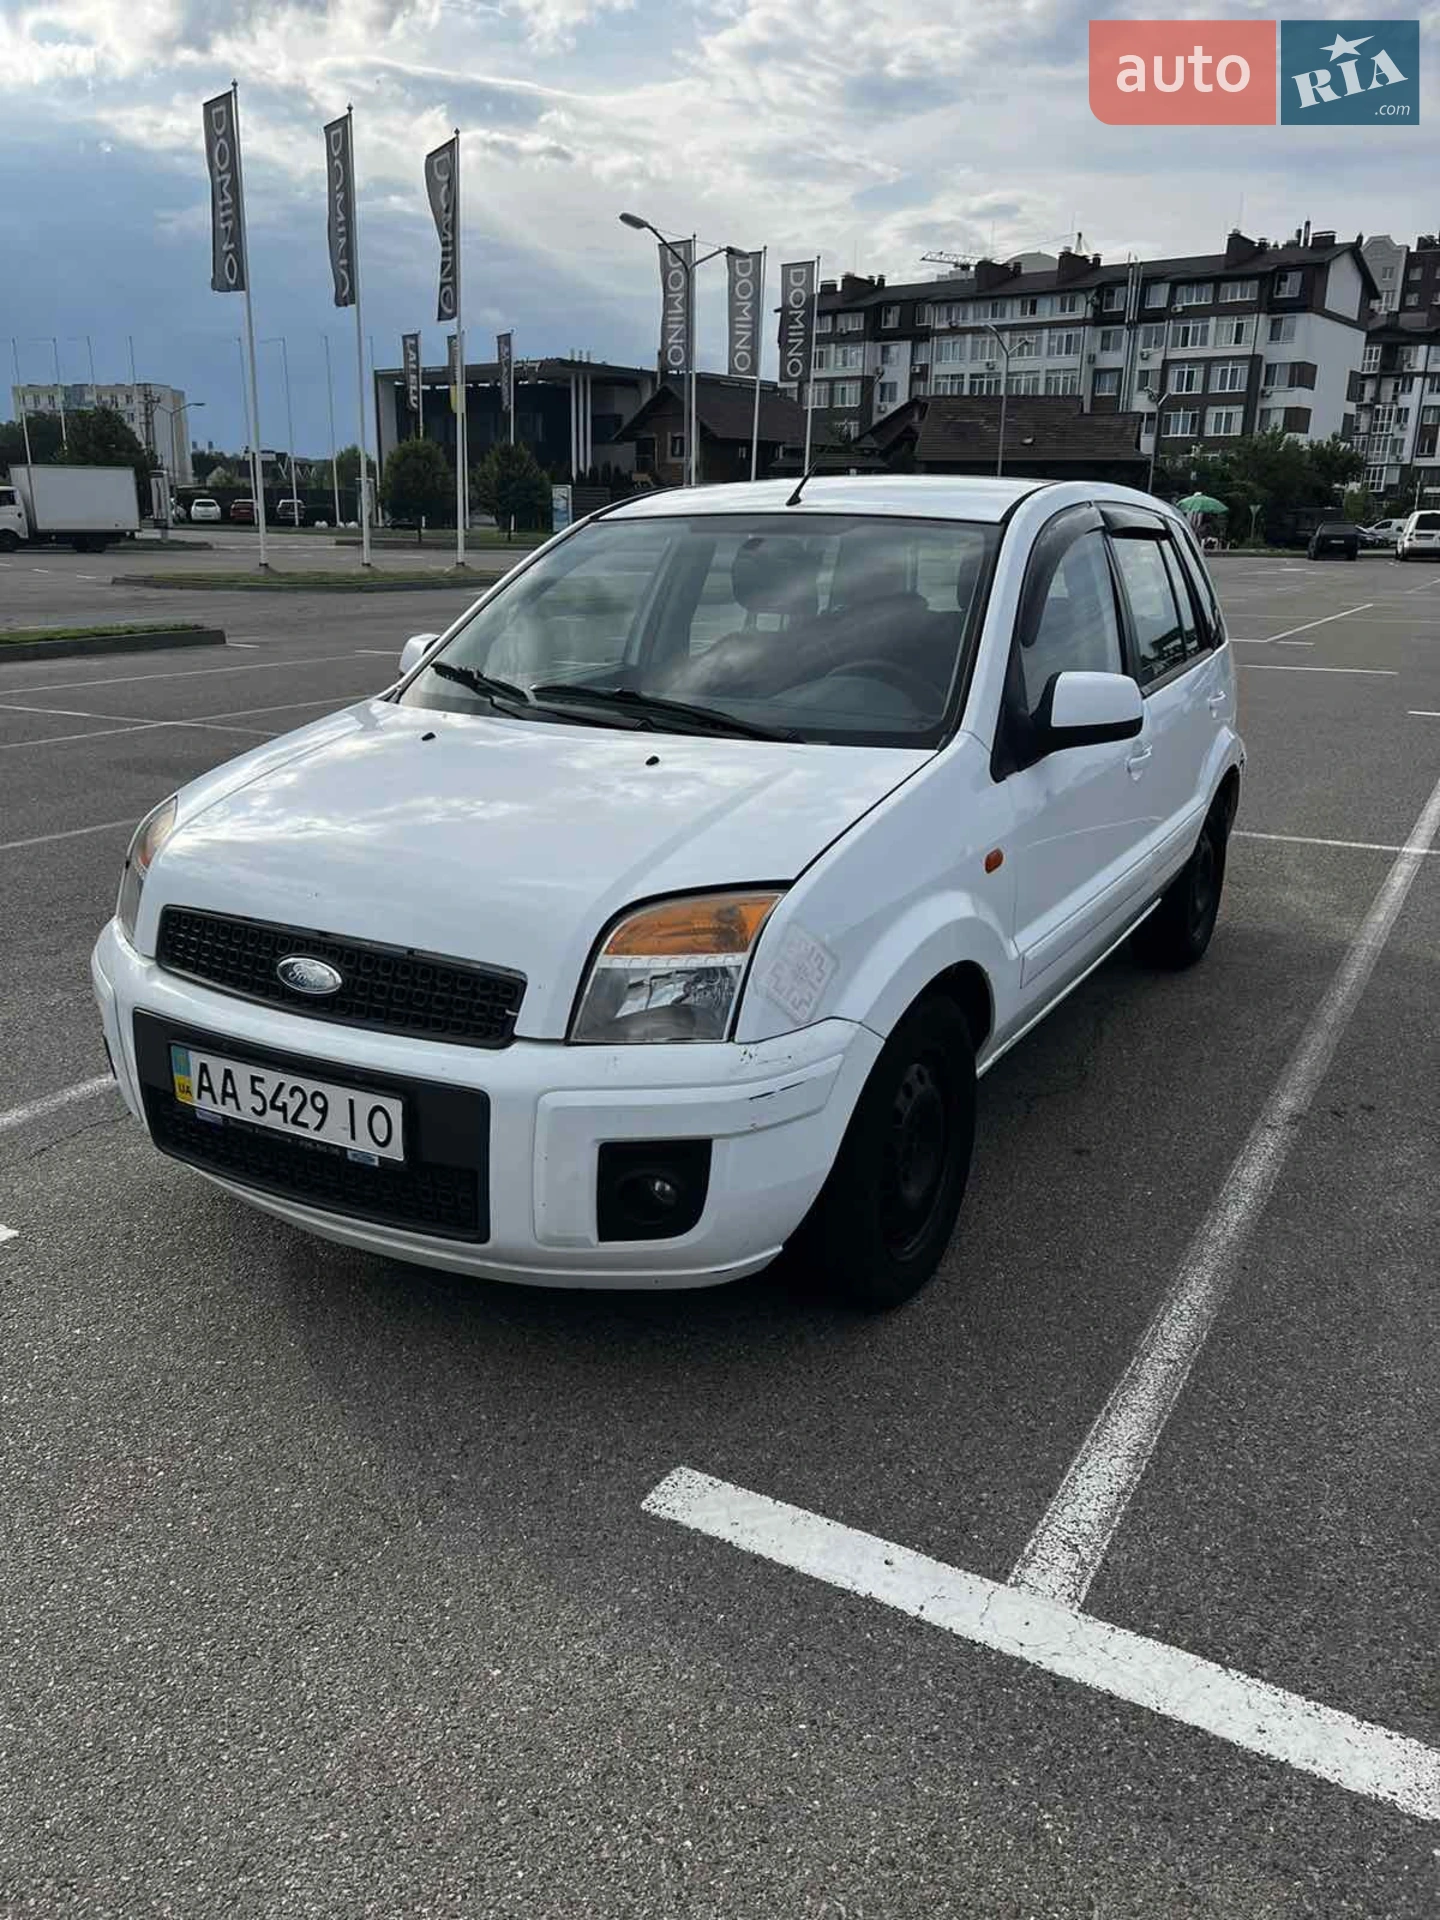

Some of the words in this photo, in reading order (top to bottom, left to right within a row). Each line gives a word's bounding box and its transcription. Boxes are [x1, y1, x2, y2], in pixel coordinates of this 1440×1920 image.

[212, 105, 238, 285] DOMINO
[667, 246, 686, 366] DOMINO
[734, 258, 753, 372] DOMINO
[786, 268, 806, 378] DOMINO
[178, 1083, 192, 1097] UA
[197, 1062, 241, 1111] AA
[250, 1074, 329, 1131] 5429
[348, 1098, 393, 1148] IO
